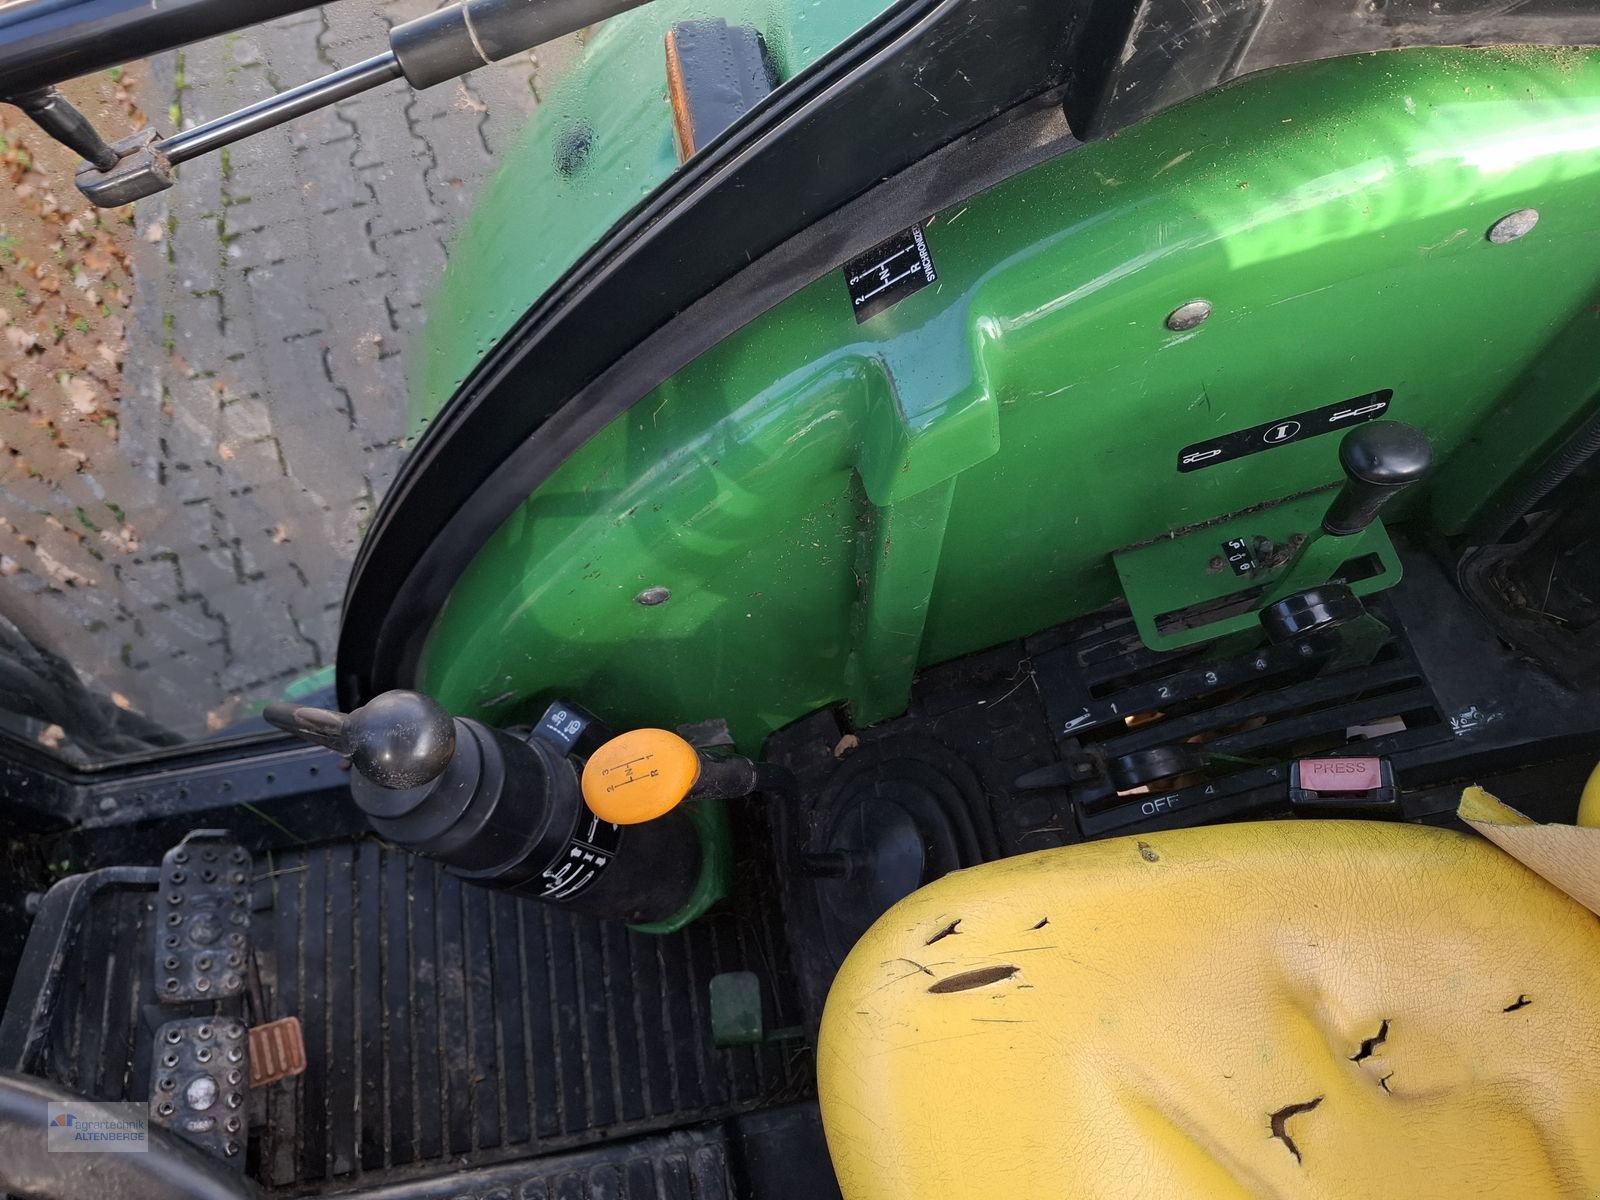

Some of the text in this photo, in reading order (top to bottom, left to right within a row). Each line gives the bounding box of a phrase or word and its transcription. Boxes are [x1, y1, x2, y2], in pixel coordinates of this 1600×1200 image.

[910, 261, 921, 274] R
[879, 268, 891, 281] N
[849, 276, 860, 286] 3
[855, 295, 865, 305] 2
[1110, 703, 1118, 714] 1
[1158, 687, 1169, 698] 2
[1205, 672, 1218, 683] 3
[624, 768, 633, 776] N
[650, 769, 659, 778] R
[1313, 762, 1365, 774] PRESS
[606, 785, 615, 793] 2
[1141, 793, 1179, 815] OFF
